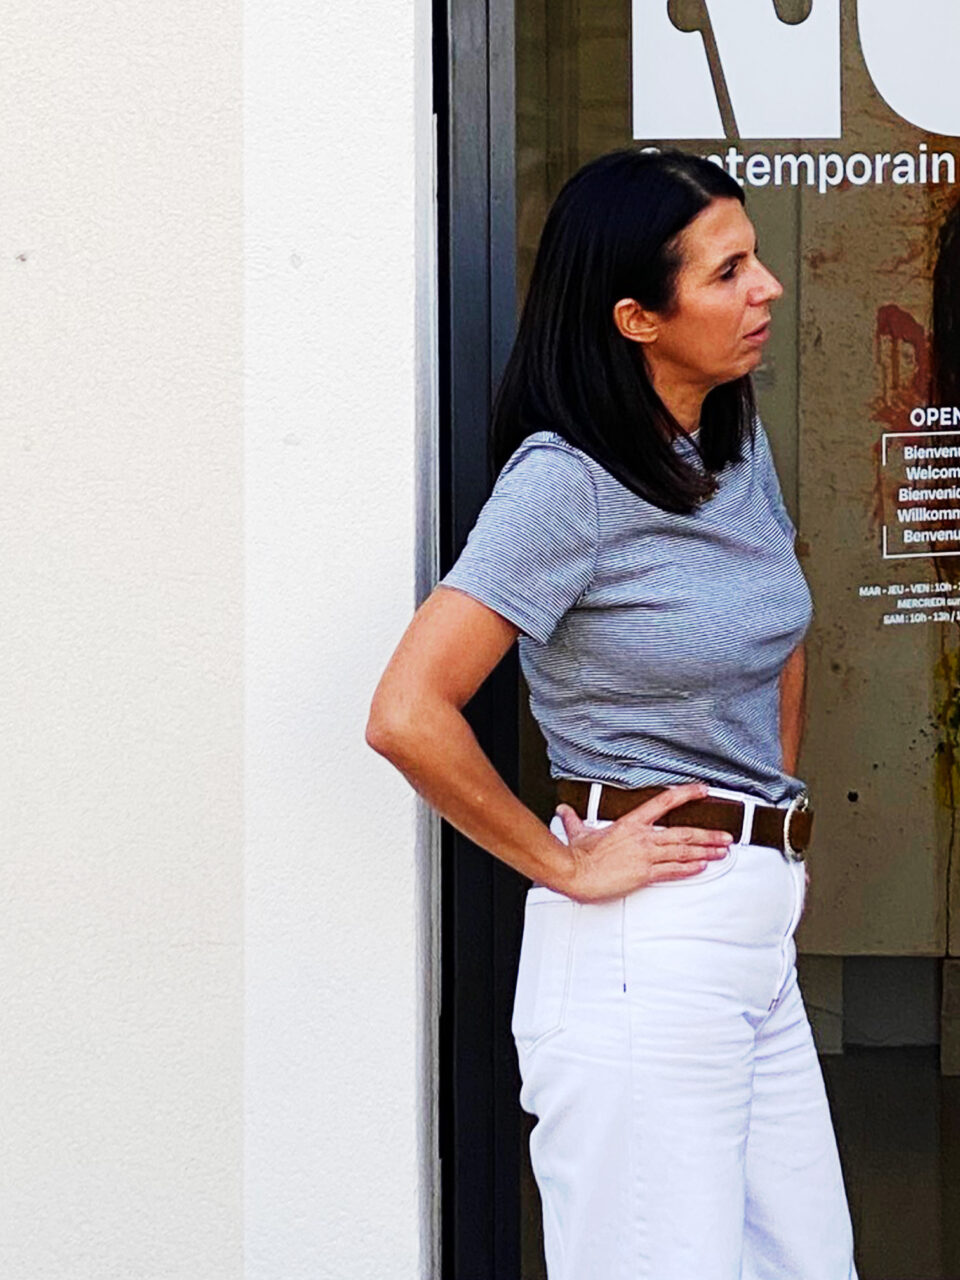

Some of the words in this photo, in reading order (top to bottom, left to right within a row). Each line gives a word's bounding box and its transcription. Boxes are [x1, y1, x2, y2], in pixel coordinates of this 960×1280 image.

[640, 144, 956, 194] temporain
[859, 586, 881, 597] MAR
[888, 584, 904, 595] JEU
[897, 596, 946, 609] MERCREDI
[883, 613, 905, 625] SAM
[910, 612, 927, 624] 10h
